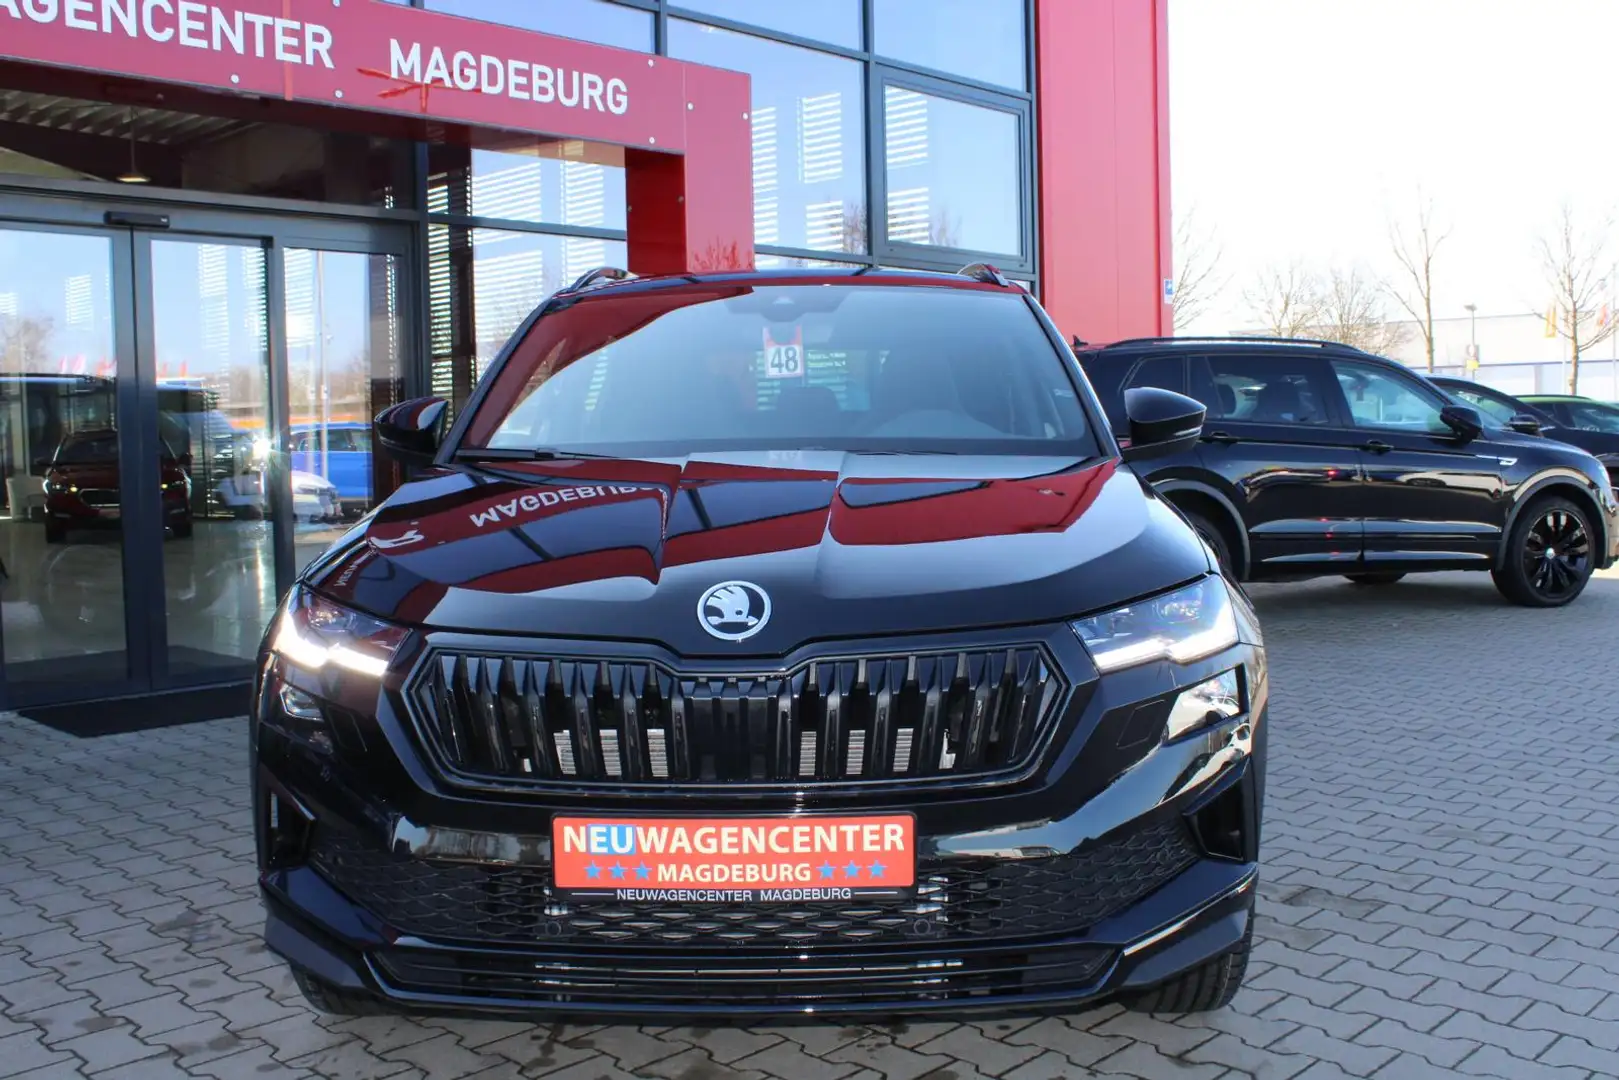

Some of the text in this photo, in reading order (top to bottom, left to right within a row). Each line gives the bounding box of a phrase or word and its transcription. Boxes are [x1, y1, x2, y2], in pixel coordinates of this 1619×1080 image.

[389, 38, 628, 115] MAGDEBURG
[770, 346, 799, 373] 48
[563, 824, 905, 854] NEUWAGENCENTER
[657, 862, 811, 883] MAGDEBURG
[616, 887, 851, 902] NEUWAGENCENTER MAGDEBURG
